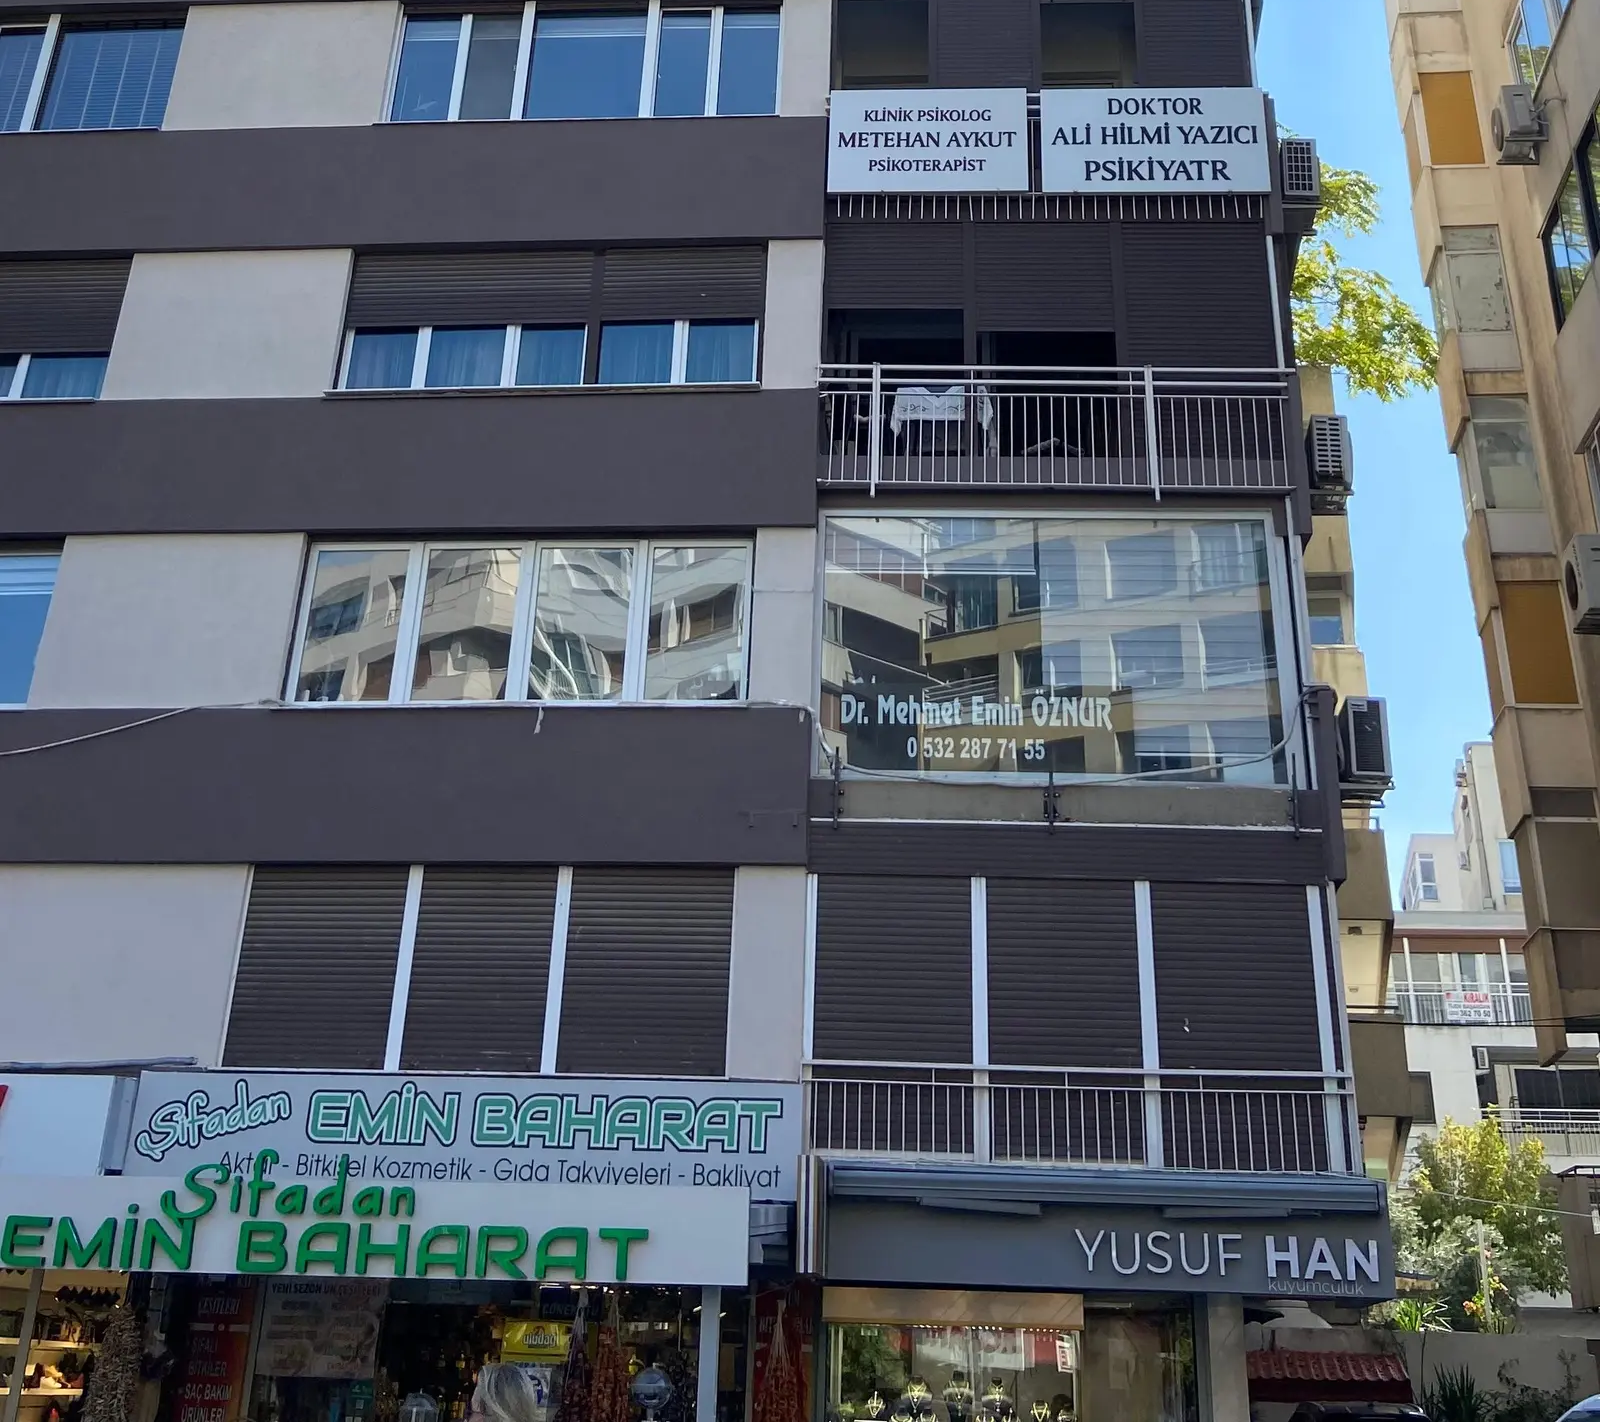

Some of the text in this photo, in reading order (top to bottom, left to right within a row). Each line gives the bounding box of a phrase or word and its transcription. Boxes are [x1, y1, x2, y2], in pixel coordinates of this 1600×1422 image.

[864, 105, 992, 122] KLİNİK PSİKOLOG
[1107, 98, 1204, 116] DOKTOR
[838, 131, 1017, 148] METEHAN AYKUT
[1051, 122, 1259, 146] ALİ HİLMİ YAZICI
[868, 155, 986, 172] PSİKOTERAPİST
[1084, 155, 1232, 181] PSİKİYATR
[840, 689, 1113, 731] Dr. Mehmet Emin ÖZNUR
[906, 737, 1045, 760] 0 532 287 71 55
[305, 1080, 462, 1147] EMİN
[470, 1092, 783, 1154] BAHARAT
[296, 1153, 366, 1178] Bitkiel
[373, 1155, 472, 1180] Kozmetik
[493, 1158, 550, 1182] Gıda
[558, 1159, 671, 1185] Takviyeleri
[692, 1163, 781, 1188] Bakliyat
[0, 1203, 649, 1282] EMİN BAHARAT
[1074, 1228, 1380, 1283] YUSUF HAN
[1268, 1277, 1364, 1296] kuyumculuk
